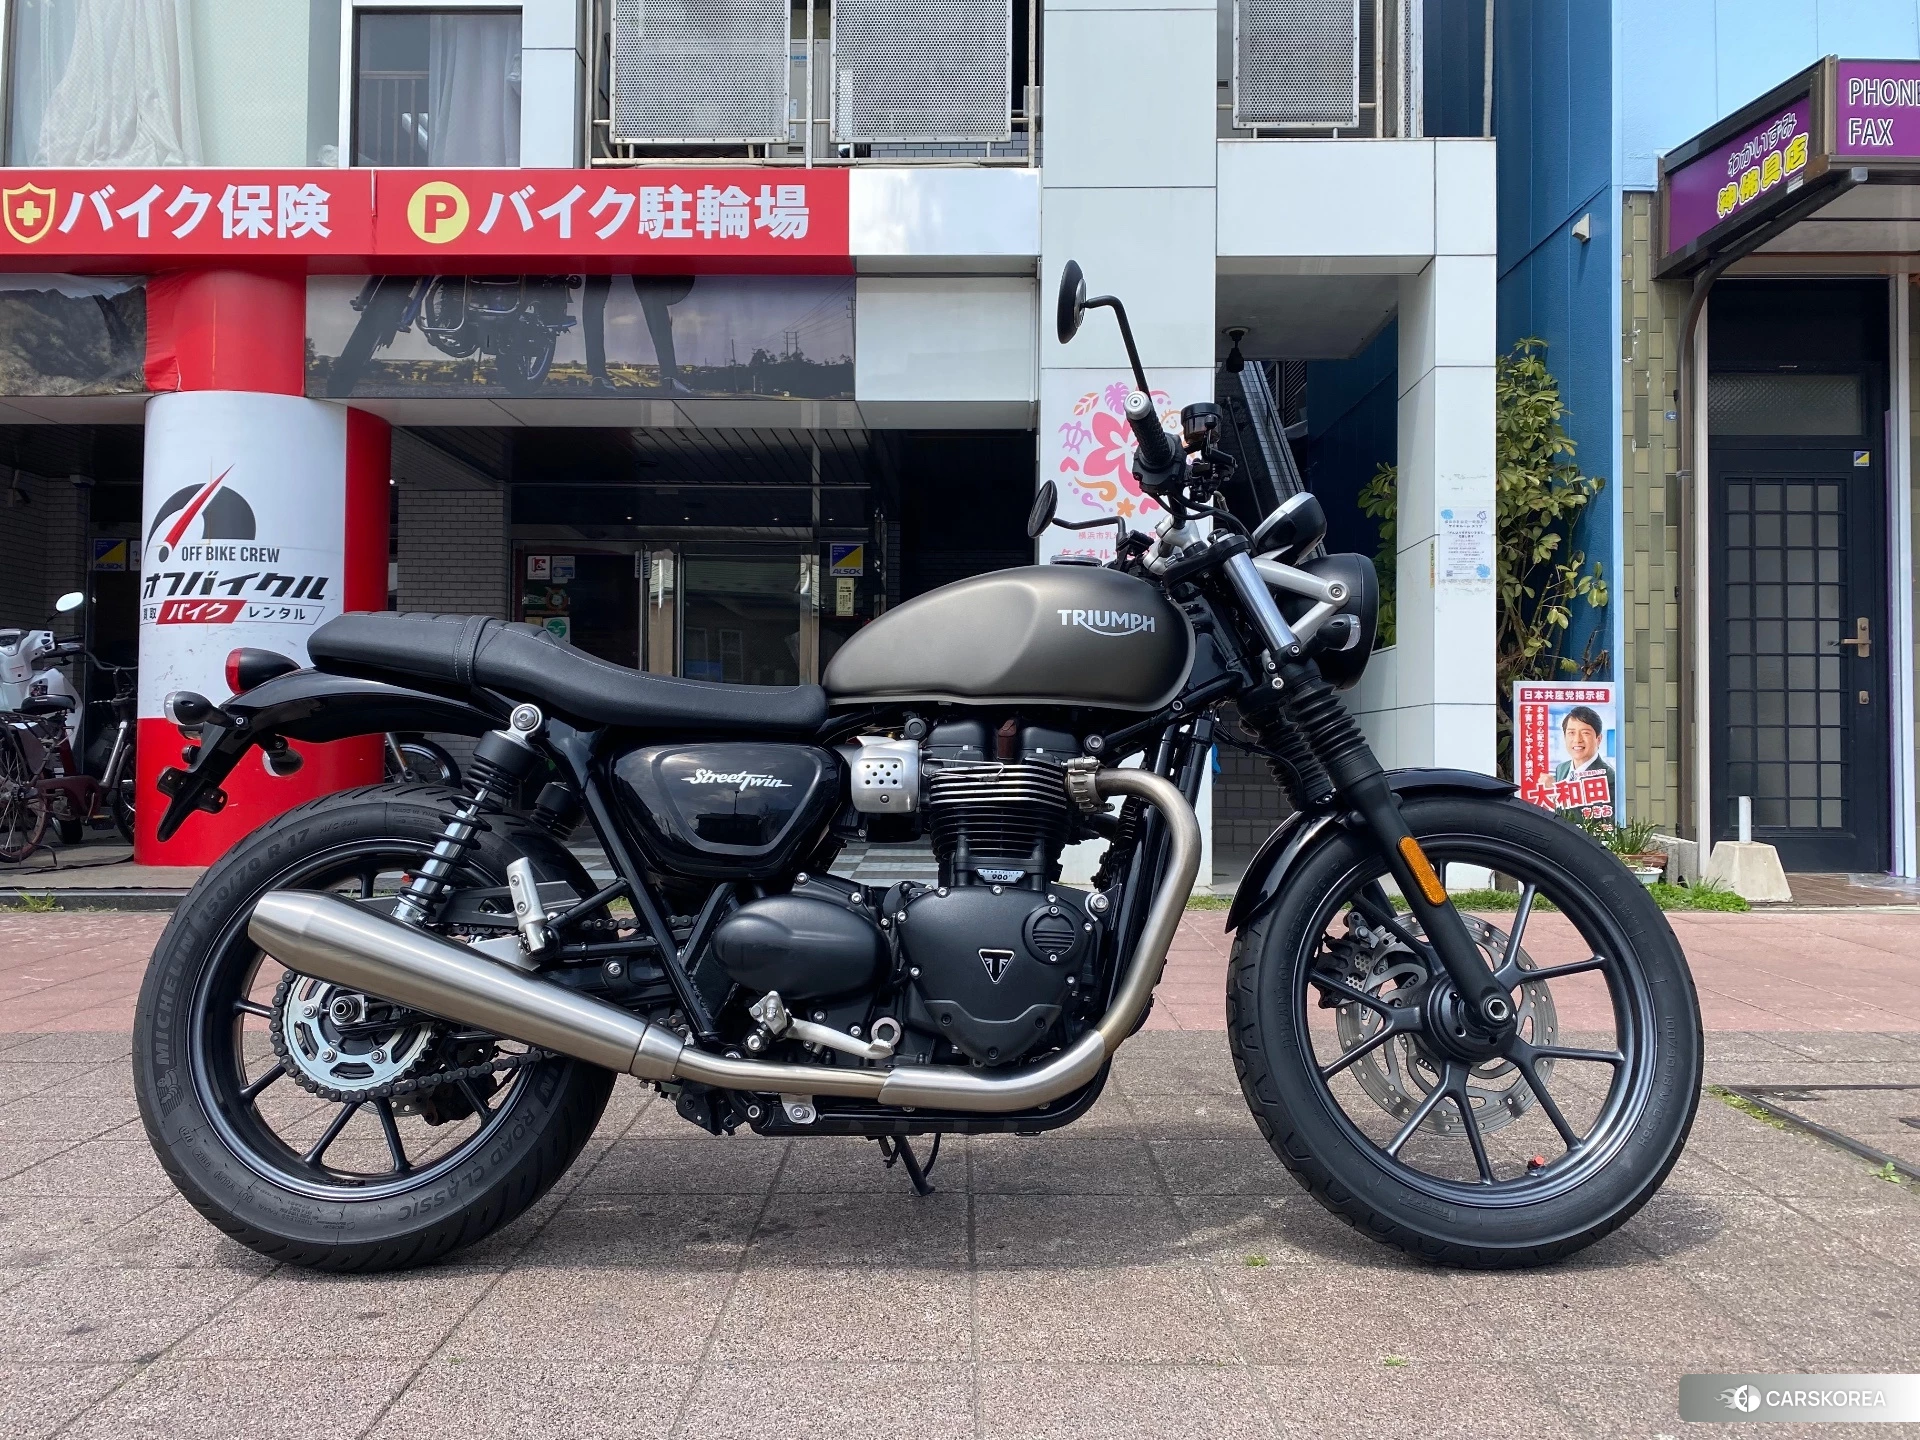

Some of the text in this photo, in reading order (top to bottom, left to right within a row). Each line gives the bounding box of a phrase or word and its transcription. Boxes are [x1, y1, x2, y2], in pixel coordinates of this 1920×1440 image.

[1849, 118, 1893, 146] FAX
[58, 183, 332, 239] バイク保険
[478, 184, 810, 240] バイク駐輪場
[1078, 531, 1117, 540] 横浜市乳
[181, 546, 280, 563] OFF BIKE CREW
[143, 571, 329, 601] オフバイクル
[167, 602, 229, 621] バイク
[249, 606, 306, 621] レンタル
[1057, 609, 1155, 636] TRIUMPH
[1524, 690, 1606, 701] 日本共産党掲示板
[1527, 776, 1611, 811] 大和田
[198, 857, 264, 923] 150/70
[267, 844, 283, 860] R
[288, 828, 310, 849] 17
[155, 931, 196, 1066] MICHELIN
[397, 1107, 536, 1222] ROAD CLASSIC
